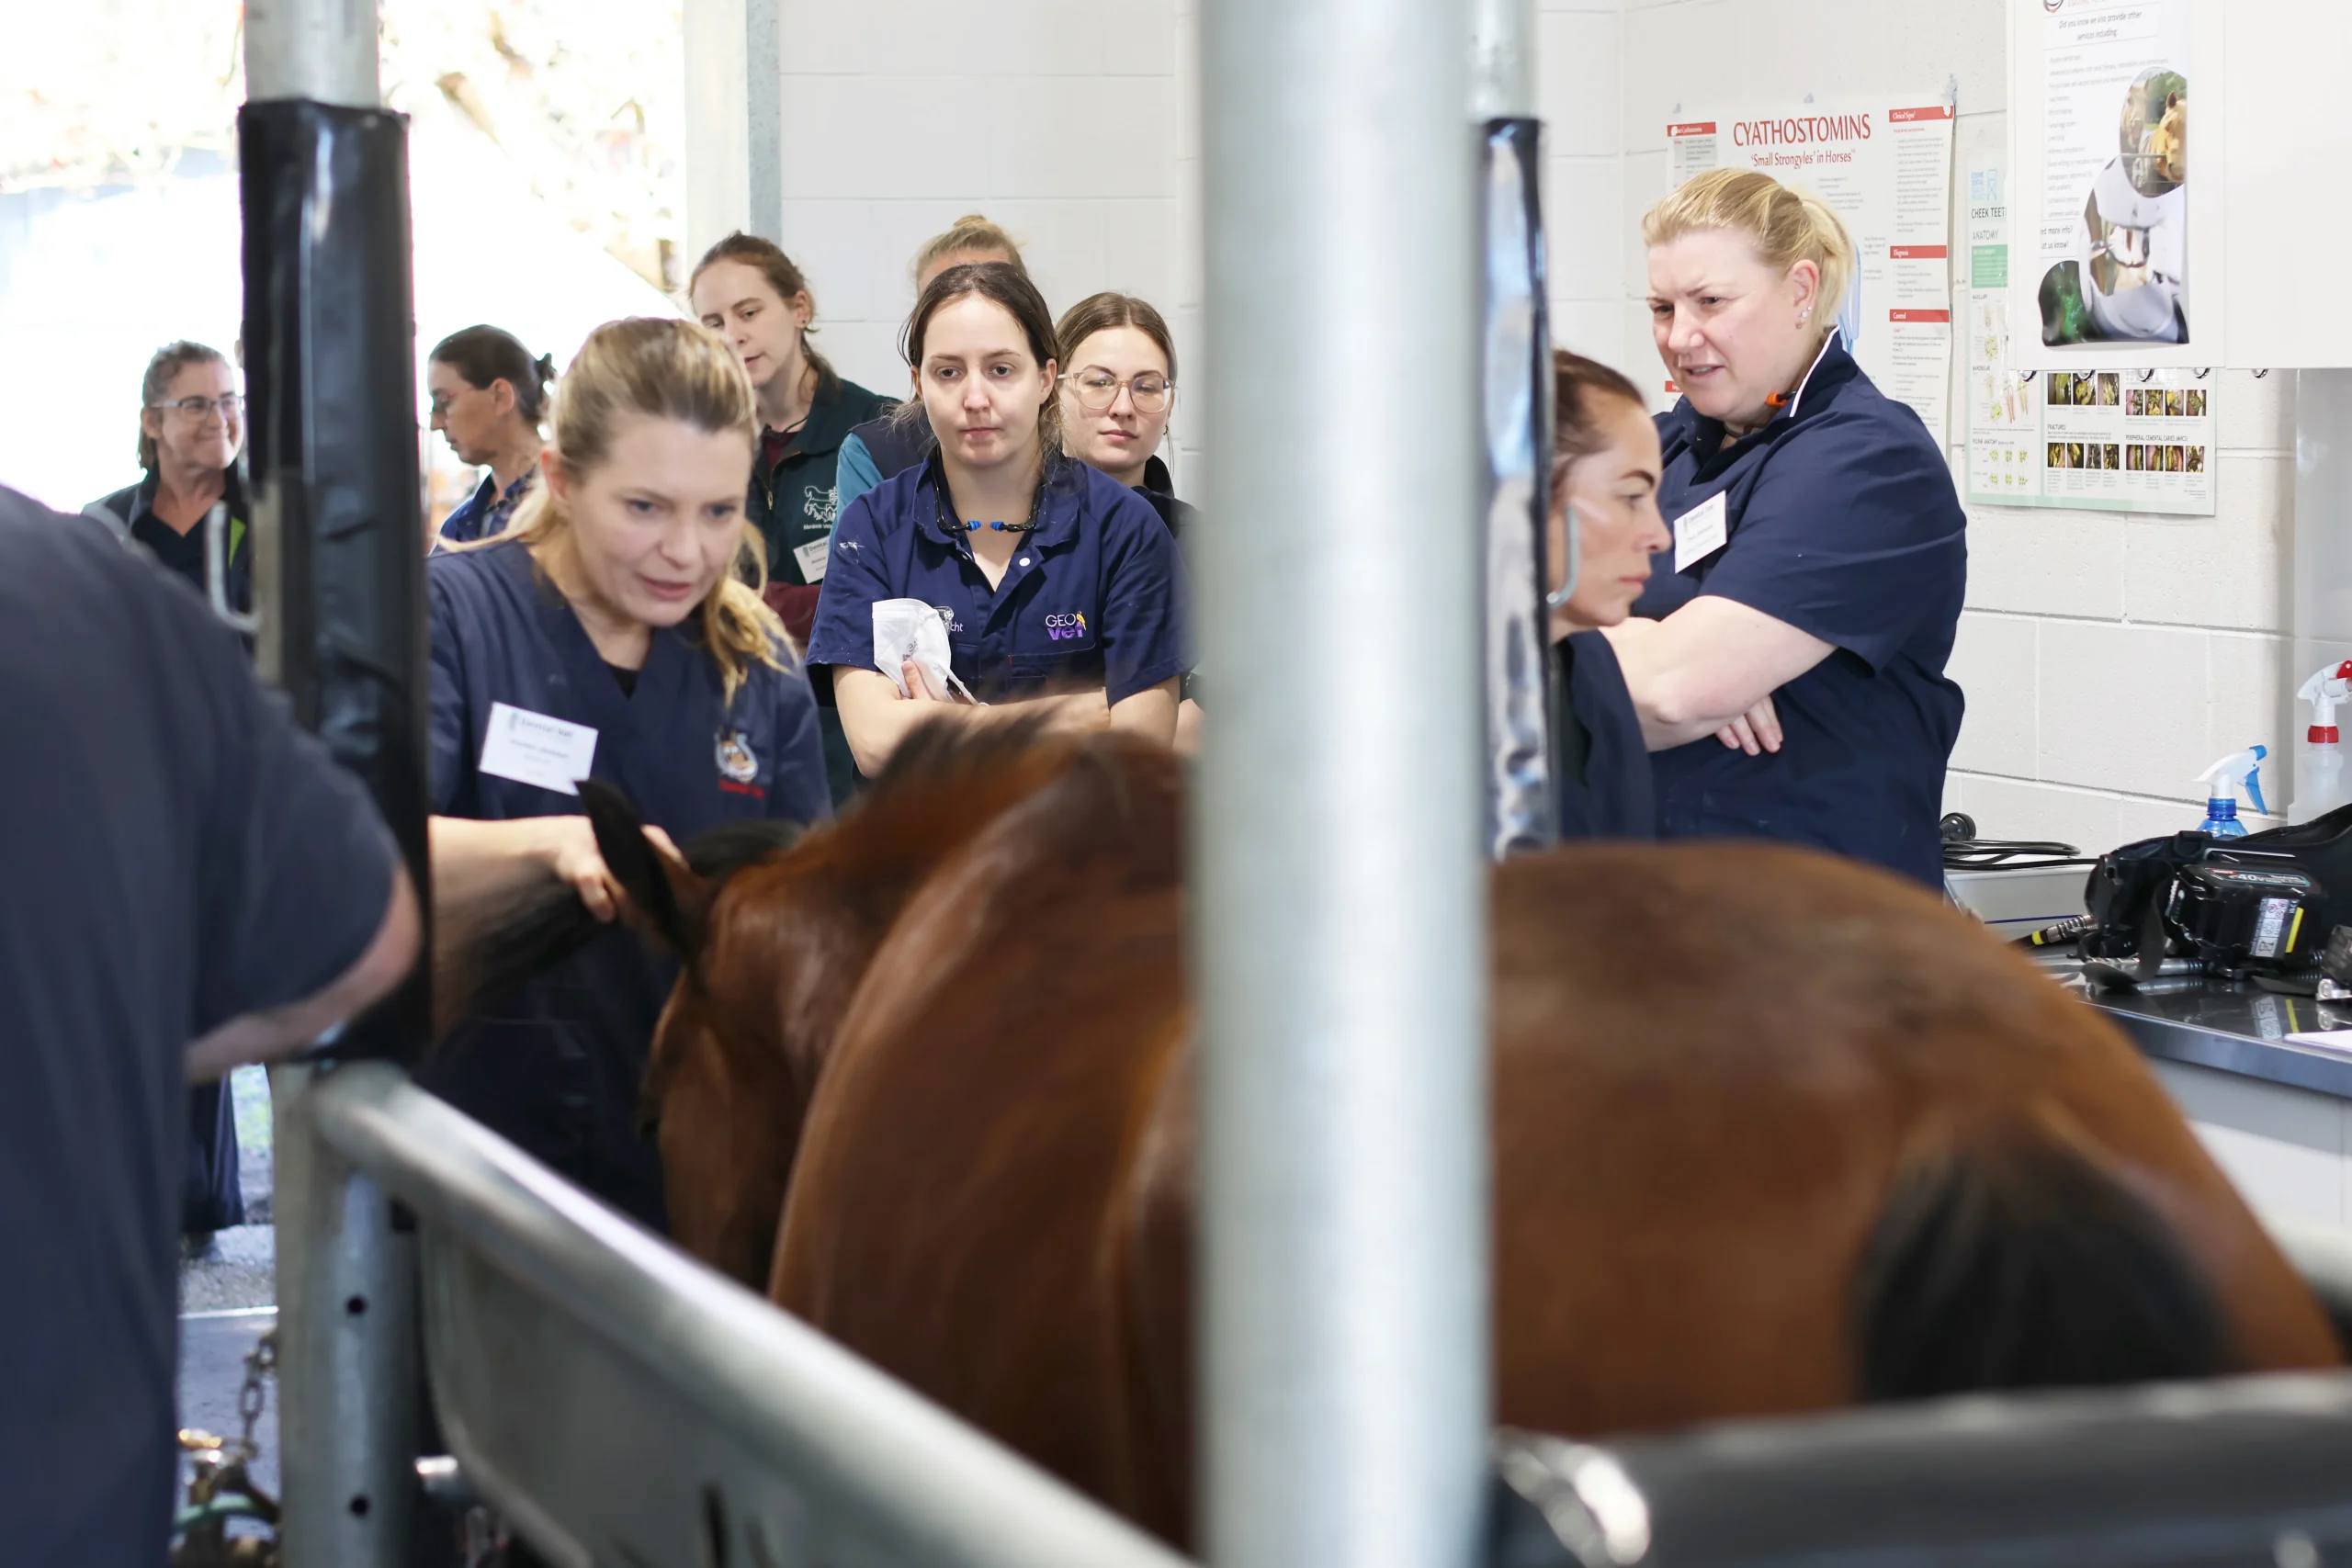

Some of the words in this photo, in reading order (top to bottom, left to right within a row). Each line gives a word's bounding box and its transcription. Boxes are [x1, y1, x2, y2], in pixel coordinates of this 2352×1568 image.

[2059, 19, 2067, 28] Did
[2068, 20, 2076, 29] you
[2107, 13, 2127, 24] provide
[2127, 11, 2142, 19] other
[2076, 32, 2095, 40] services
[1734, 113, 1871, 147] CYATHOSTOMINS
[1816, 150, 1824, 164] in
[1972, 208, 1989, 219] CHEEK
[1973, 229, 1999, 240] ANATOMY
[1893, 311, 1906, 320] Control
[803, 523, 823, 531] Murdoch
[808, 540, 828, 552] Dental
[1045, 613, 1076, 627] GEO
